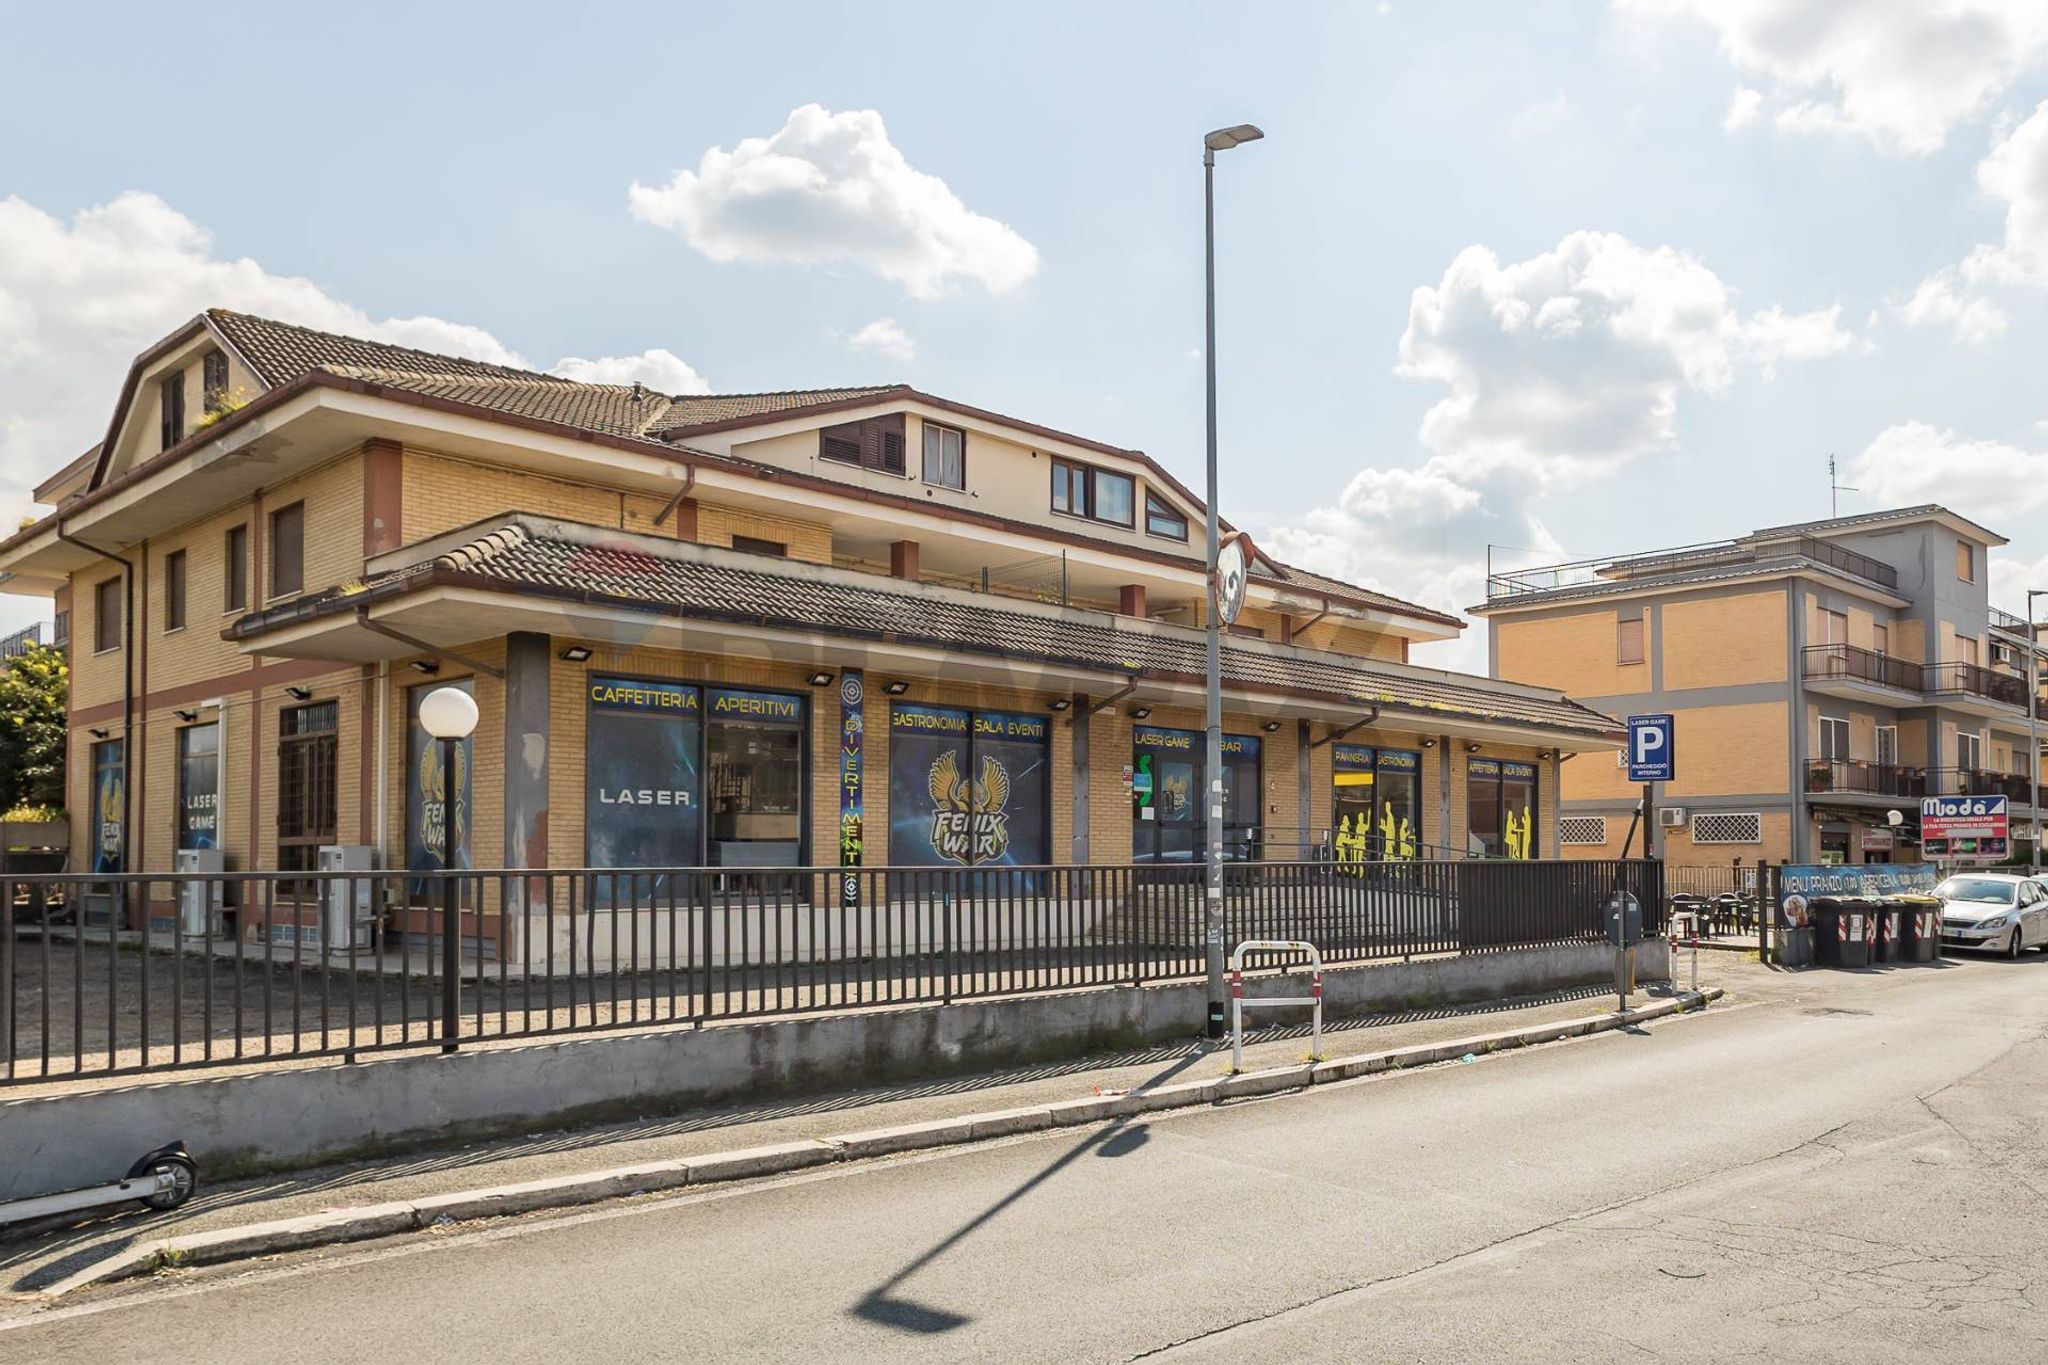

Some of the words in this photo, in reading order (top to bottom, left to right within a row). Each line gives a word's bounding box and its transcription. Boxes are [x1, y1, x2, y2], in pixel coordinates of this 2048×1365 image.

[591, 685, 698, 709] CAFFETTERIA
[715, 696, 795, 717] APERITIVI
[974, 719, 1004, 734] SALA
[1008, 721, 1043, 737] EVENTI
[1135, 732, 1164, 747] LASER
[1164, 737, 1191, 749] GAME
[1637, 726, 1664, 763] P
[187, 793, 217, 809] LASER
[600, 788, 690, 806] LASER
[188, 815, 215, 830] GAME
[1784, 875, 1808, 893] MENU
[1810, 874, 1842, 892] PRANZO
